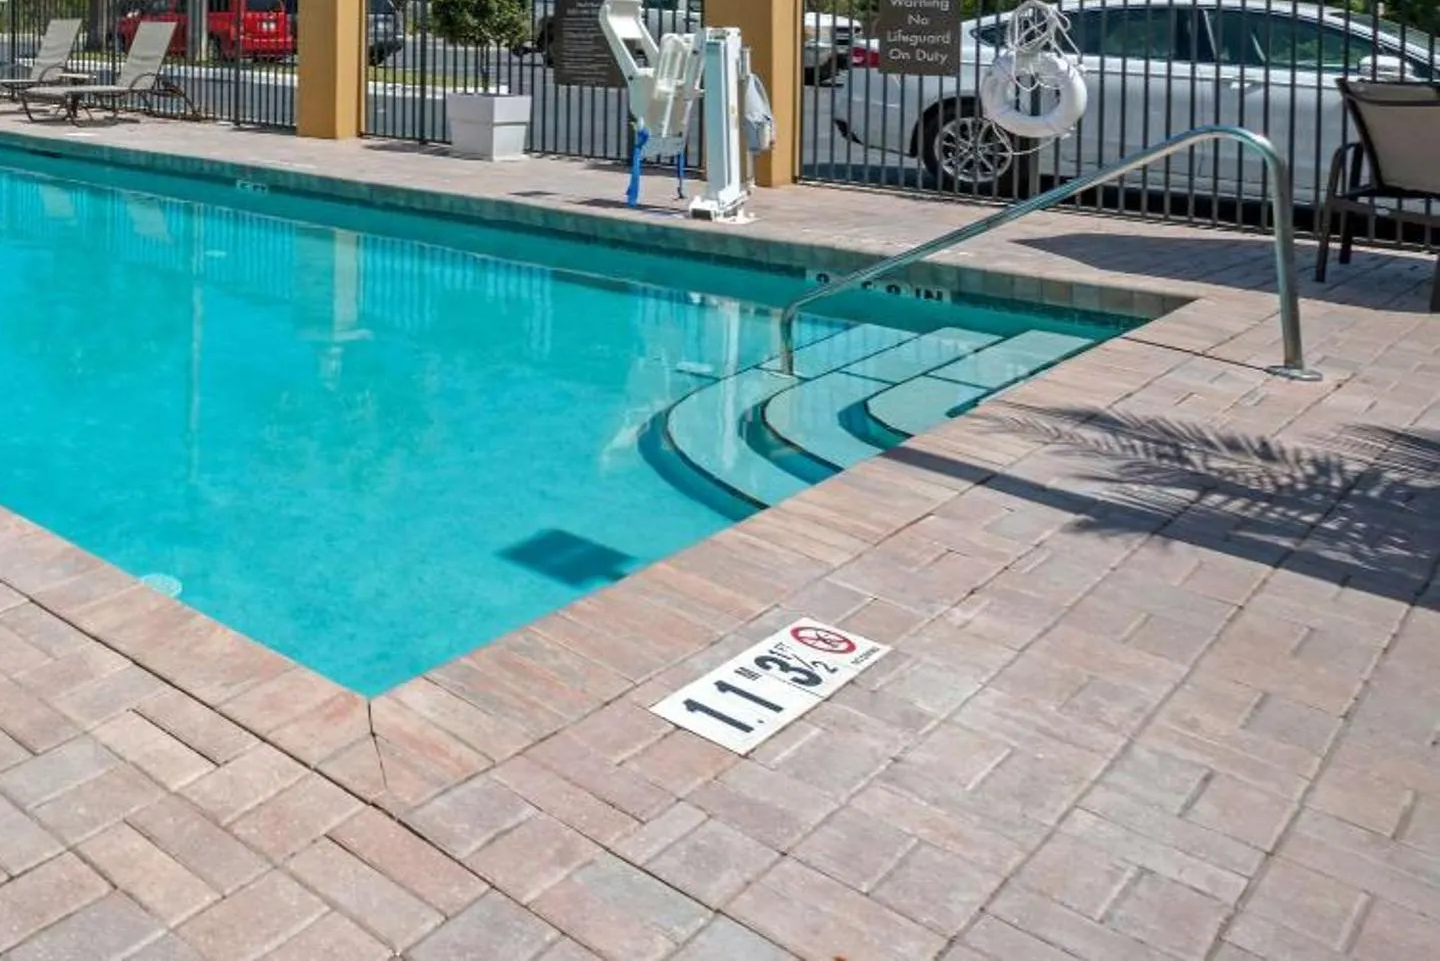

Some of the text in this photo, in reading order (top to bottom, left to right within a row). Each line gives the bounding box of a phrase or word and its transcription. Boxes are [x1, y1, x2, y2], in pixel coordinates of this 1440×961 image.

[907, 13, 929, 25] No
[886, 29, 952, 46] Lifeguard
[888, 48, 948, 64] On Duty
